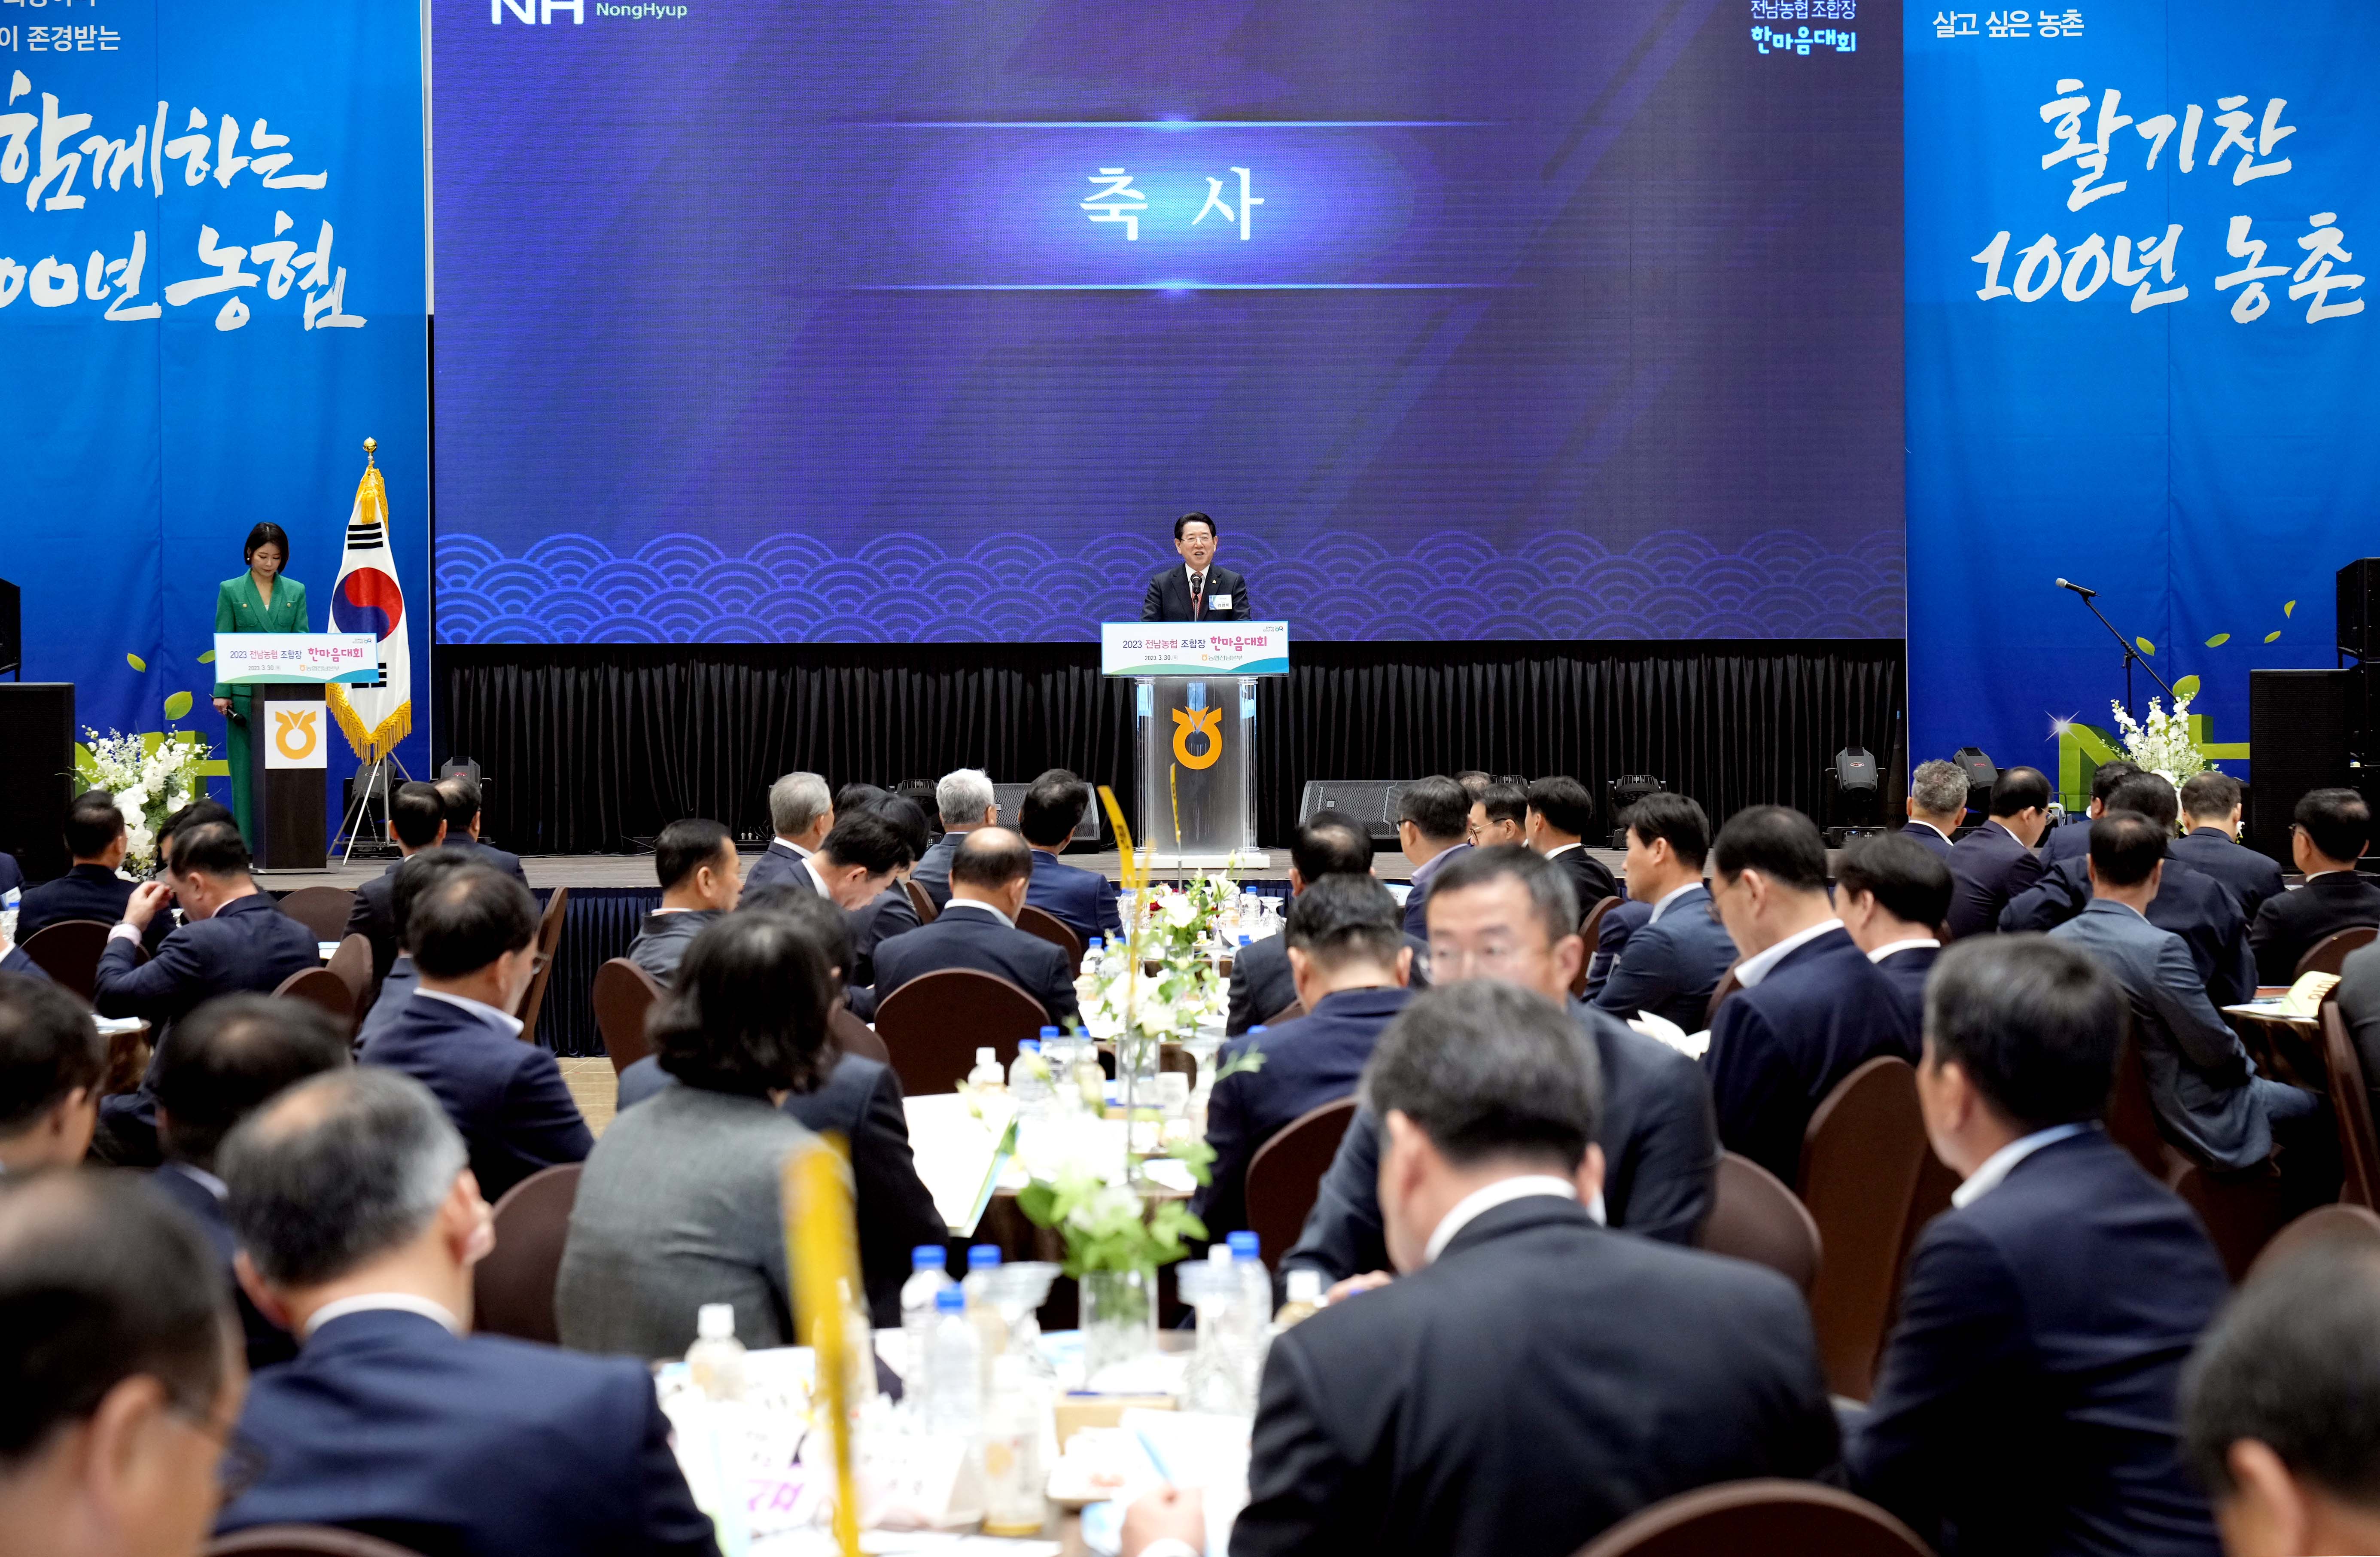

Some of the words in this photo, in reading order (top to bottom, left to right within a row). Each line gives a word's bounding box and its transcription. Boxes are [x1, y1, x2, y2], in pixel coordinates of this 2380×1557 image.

[491, 0, 584, 24] NH
[596, 3, 688, 19] NongHyup
[1751, 0, 1808, 19] 전남농협
[1811, 0, 1857, 19] 조합장
[1933, 11, 1980, 38] 살고
[1985, 10, 2032, 38] 싶은
[2037, 9, 2085, 38] 농촌
[27, 25, 121, 52] 존경받는
[1751, 26, 1856, 55] 한마음대회
[0, 70, 327, 212] 함께하는
[2040, 79, 2297, 212] 활기찬
[164, 210, 367, 331] 농협
[1971, 224, 2189, 314] 100년
[2215, 212, 2366, 324] 농촌
[250, 650, 278, 659] 전남농협
[280, 650, 302, 659] 조합장
[308, 647, 363, 662] 한마음대회
[1145, 639, 1178, 649] 전남농협
[1181, 639, 1206, 649] 조합장
[1210, 636, 1267, 651] 한마음대회
